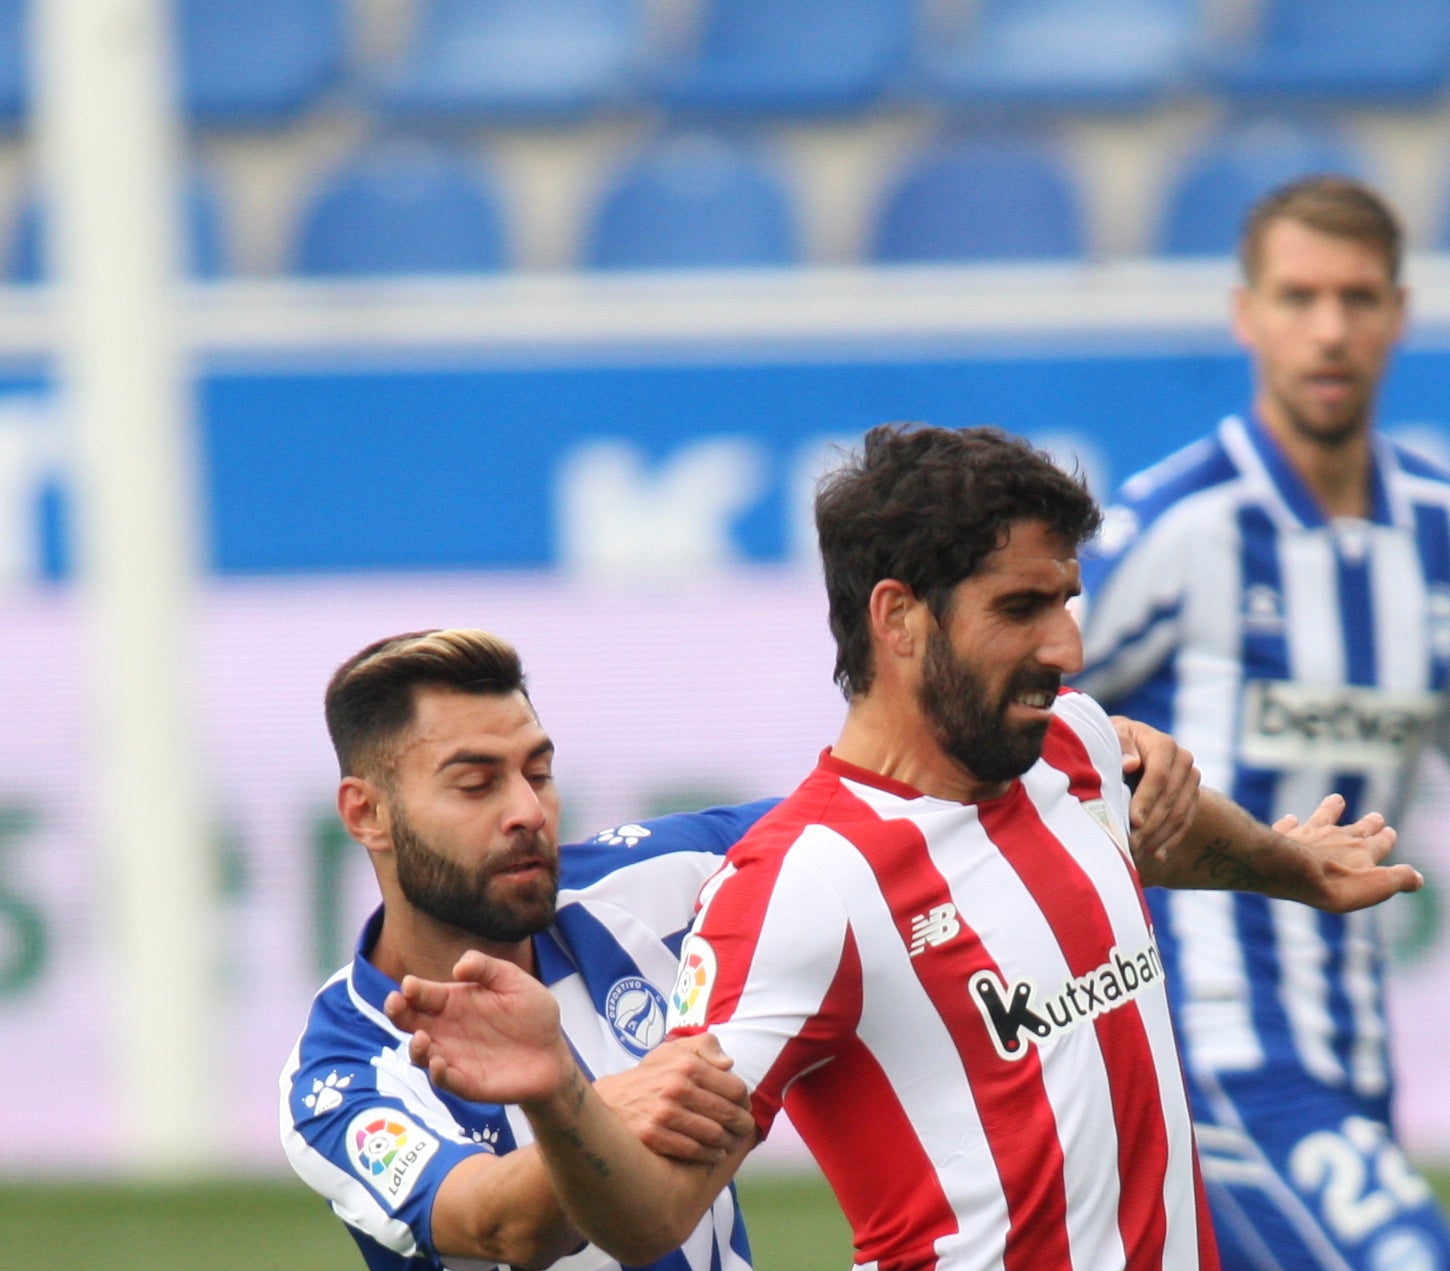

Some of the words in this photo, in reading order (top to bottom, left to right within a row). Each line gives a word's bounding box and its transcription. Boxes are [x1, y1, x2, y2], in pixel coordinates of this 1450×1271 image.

[608, 980, 642, 1019] DEPORTIVO
[976, 938, 1164, 1053] Kutxaban
[388, 1141, 427, 1196] LaLiga
